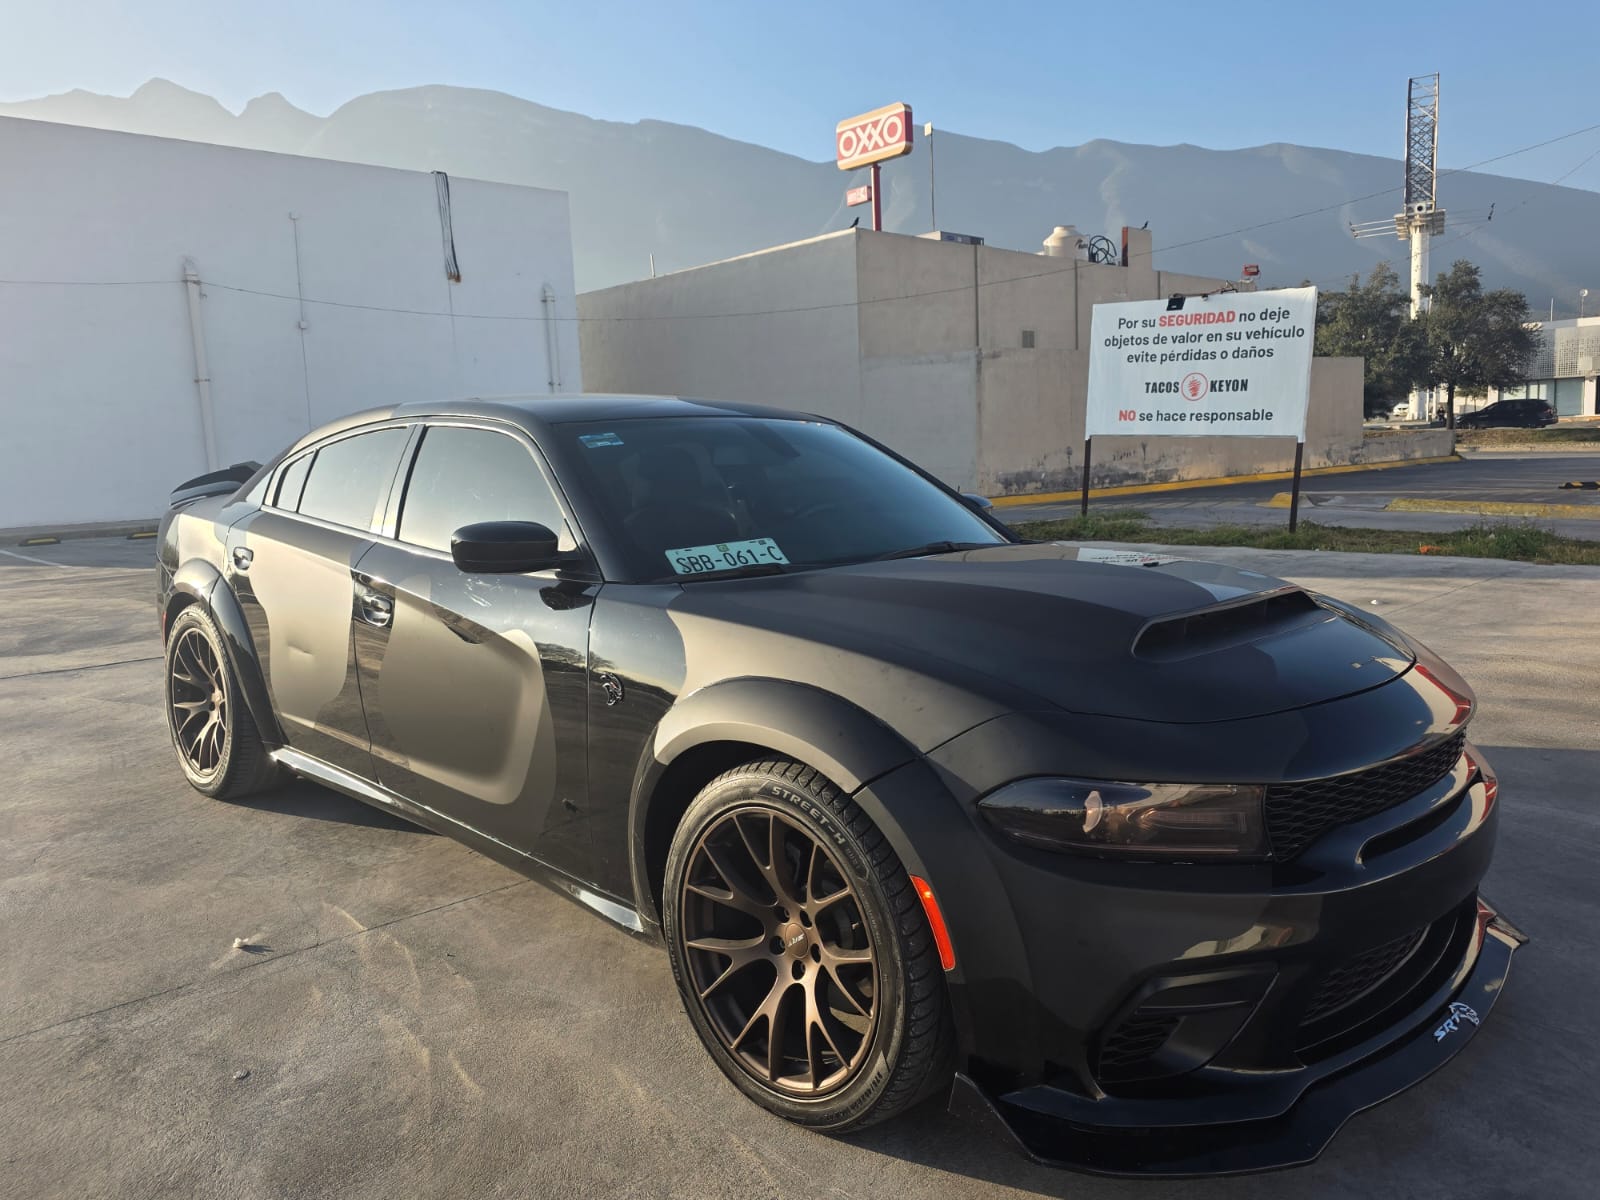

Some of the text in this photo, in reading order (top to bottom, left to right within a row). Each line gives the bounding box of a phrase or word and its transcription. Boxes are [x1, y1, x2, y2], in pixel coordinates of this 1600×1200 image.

[839, 116, 902, 157] OXXO
[1118, 308, 1290, 329] Por su SEGURIDAD no deje
[1104, 326, 1305, 351] objetos de valor en su vehículo
[1127, 346, 1274, 365] evite pérdidas o daños
[1145, 379, 1249, 394] TACOS KEYON
[1119, 409, 1273, 424] NO se hace responsable
[676, 546, 783, 573] SBB-061-C
[771, 785, 846, 845] STREET-H
[1434, 1011, 1459, 1042] SRT
